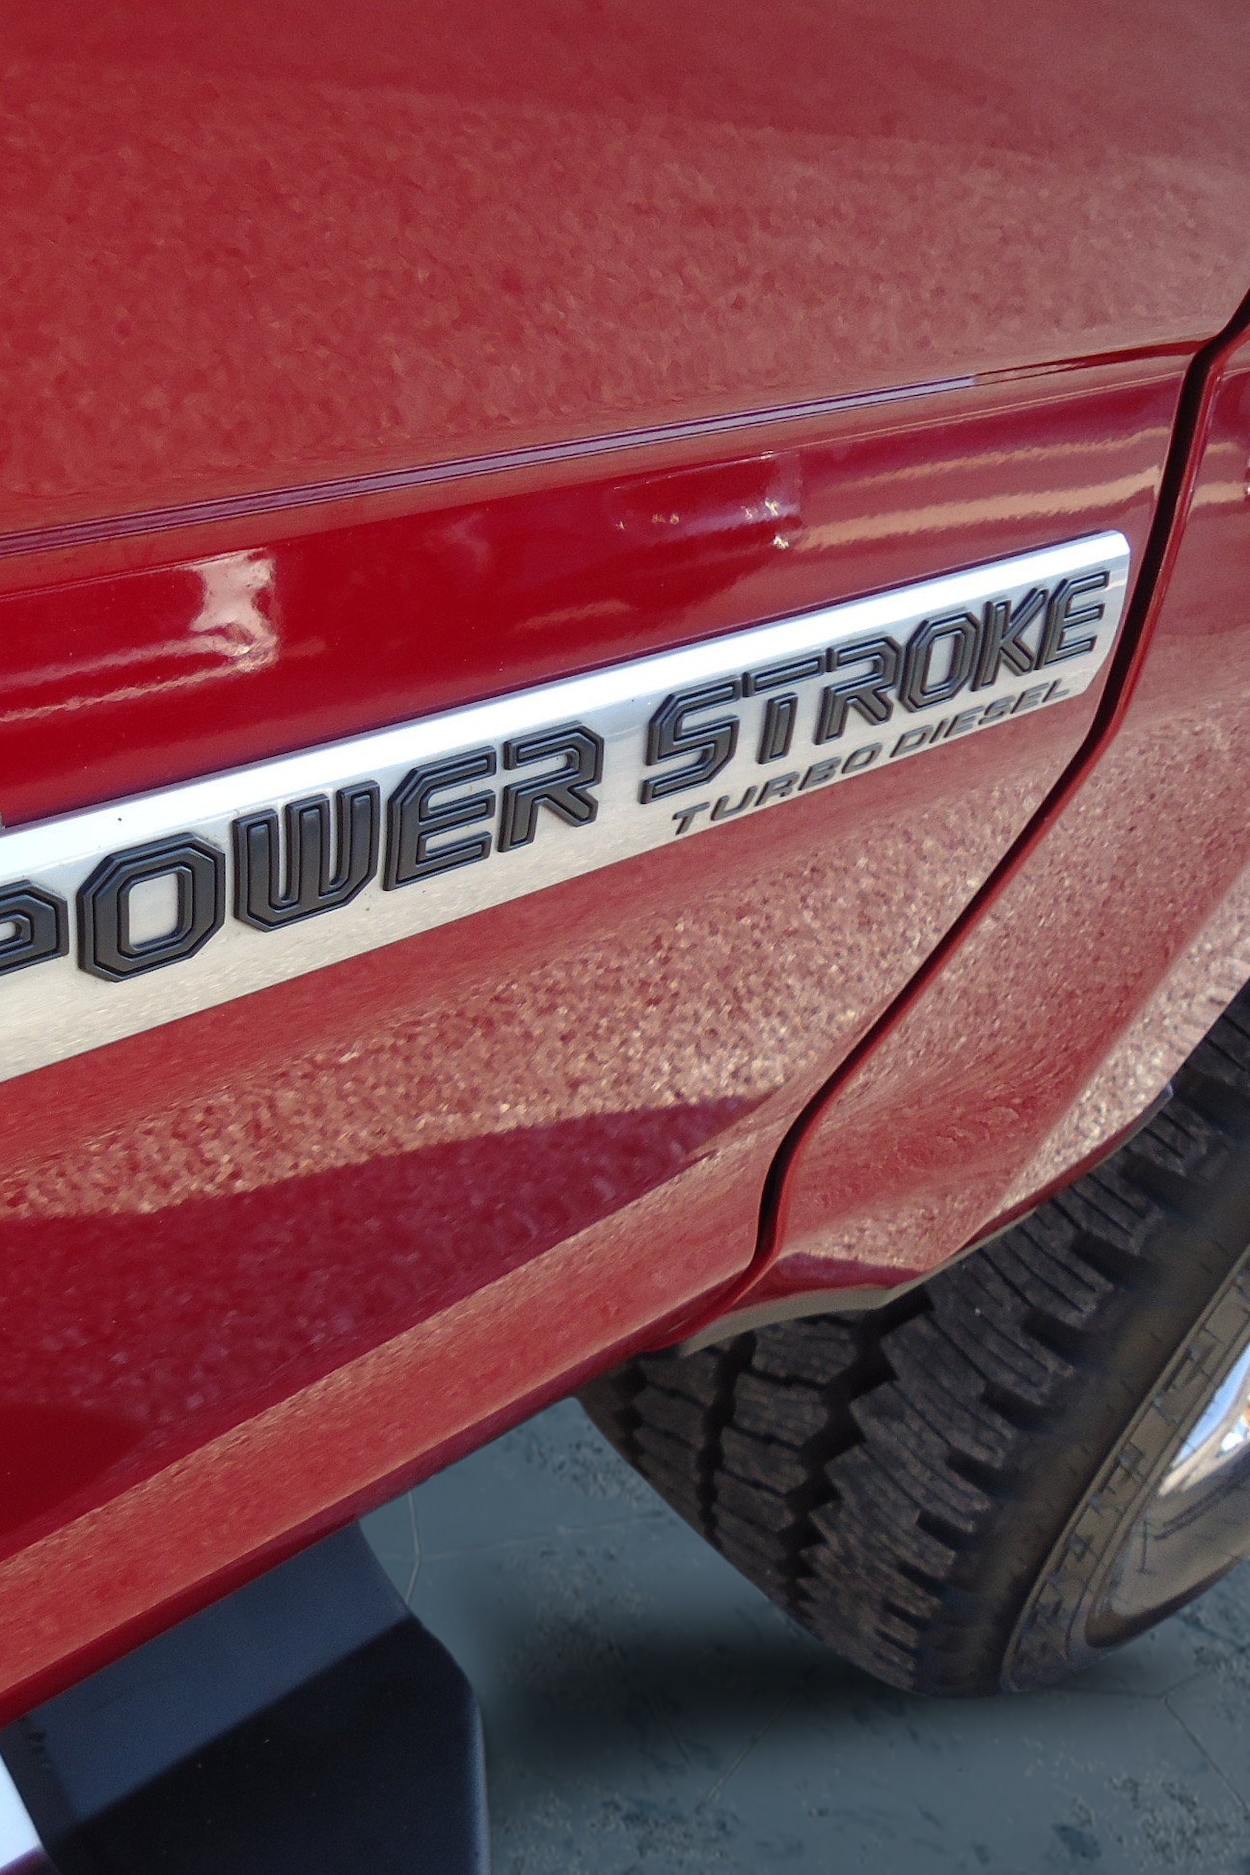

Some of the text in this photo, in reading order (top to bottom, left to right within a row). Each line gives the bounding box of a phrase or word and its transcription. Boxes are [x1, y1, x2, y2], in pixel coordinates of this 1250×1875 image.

[639, 568, 1110, 805] STROKE
[671, 679, 1070, 836] TURBO DIESEL
